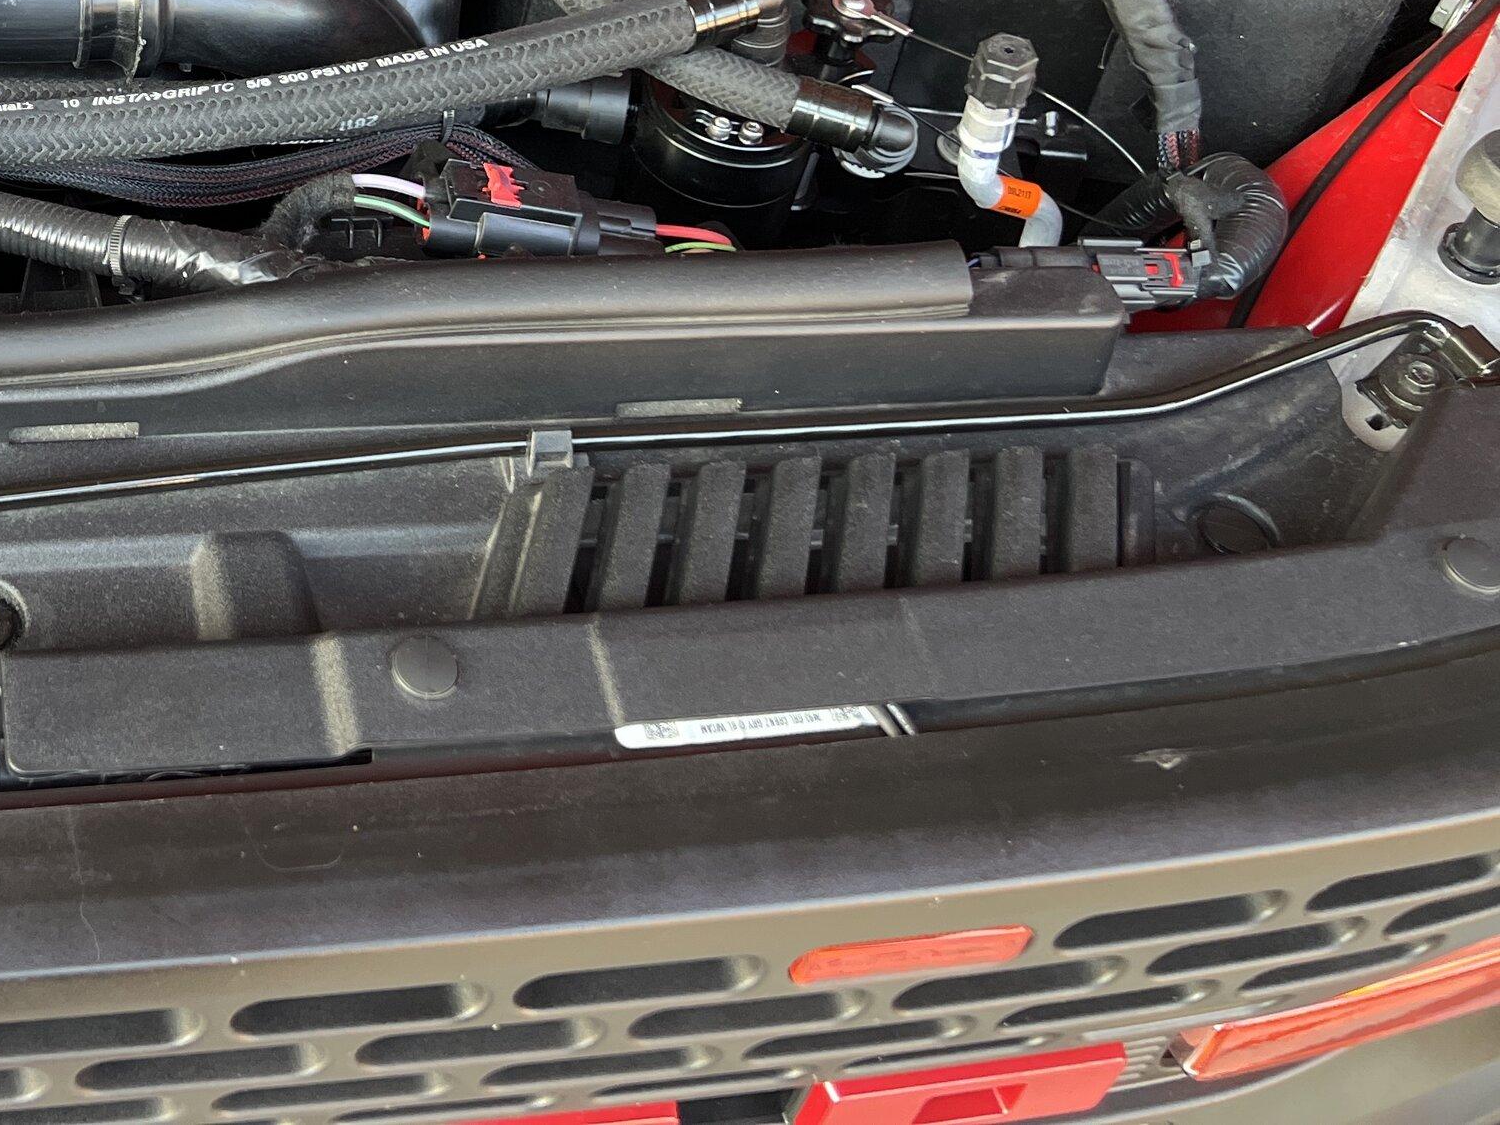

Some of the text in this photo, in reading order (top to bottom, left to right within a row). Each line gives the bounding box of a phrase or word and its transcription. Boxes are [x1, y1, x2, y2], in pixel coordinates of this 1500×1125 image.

[60, 99, 80, 109] 10
[210, 82, 235, 94] TC
[245, 77, 271, 89] 5/8
[278, 71, 309, 84] 300
[311, 67, 340, 80] PSI
[340, 62, 369, 75] WP
[376, 52, 429, 68] MADE
[430, 45, 449, 58] IN
[450, 38, 489, 54] USA
